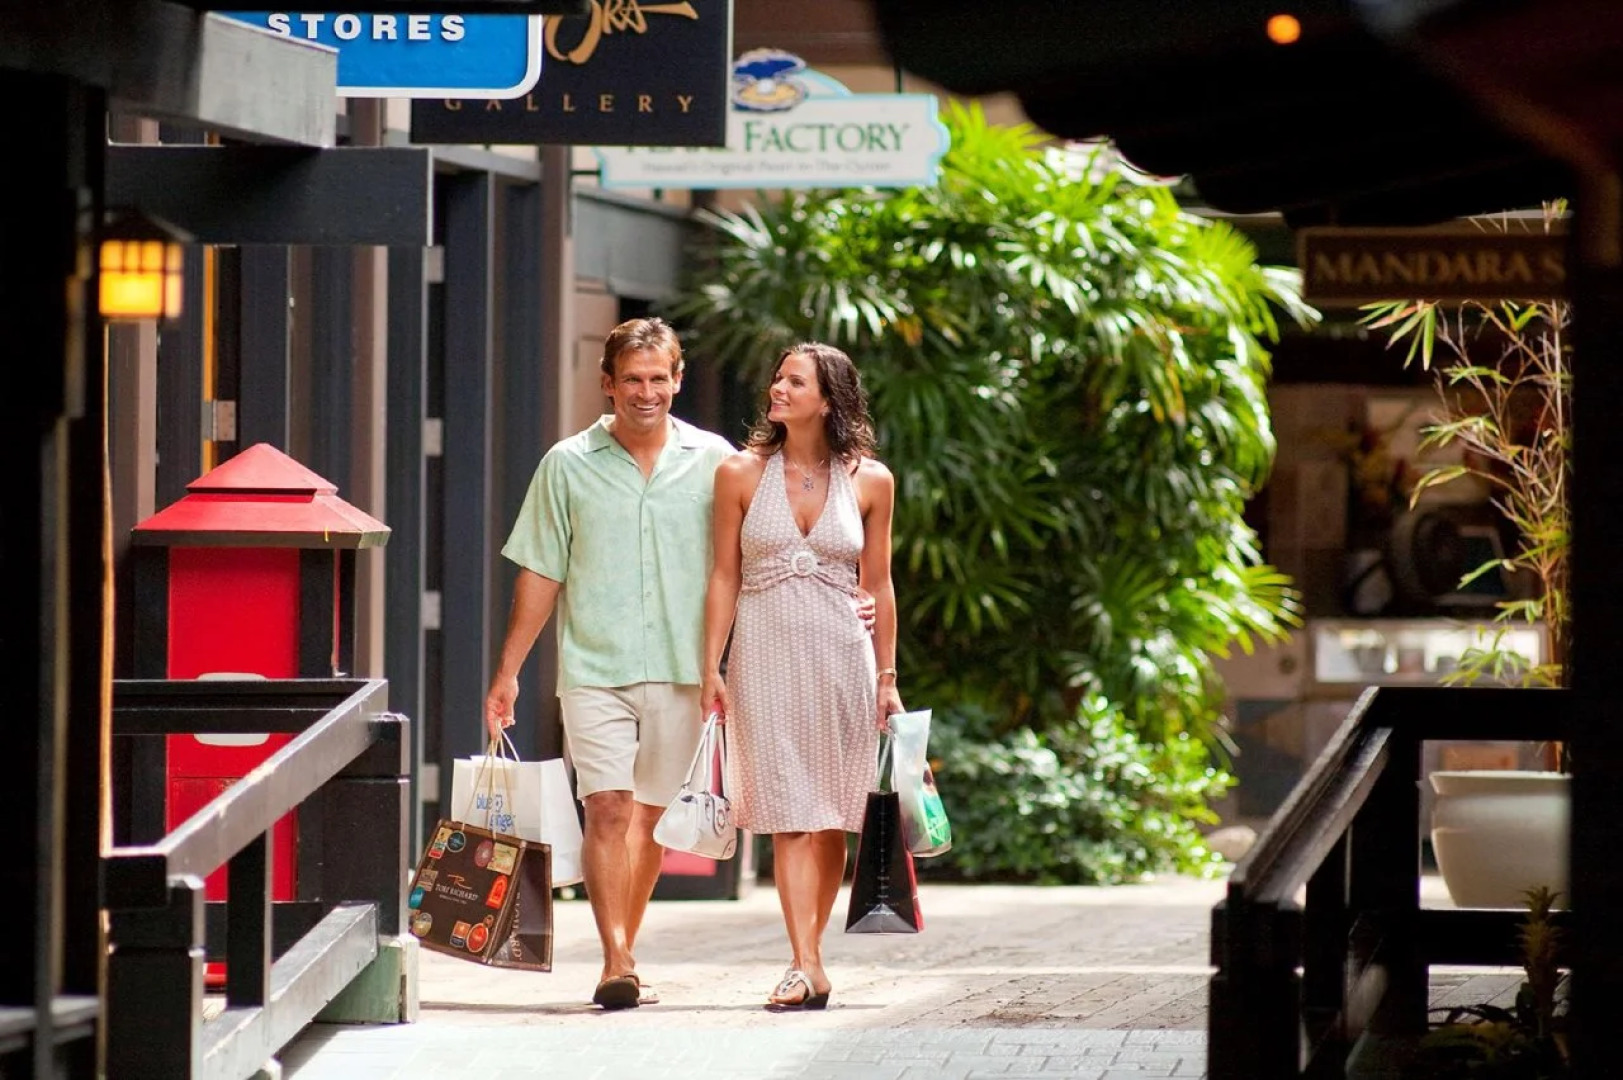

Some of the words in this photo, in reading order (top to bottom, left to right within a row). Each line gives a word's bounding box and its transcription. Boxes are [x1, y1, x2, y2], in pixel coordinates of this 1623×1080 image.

[268, 13, 466, 41] STORES
[443, 94, 693, 112] GALLERY
[743, 120, 909, 152] FACTORY
